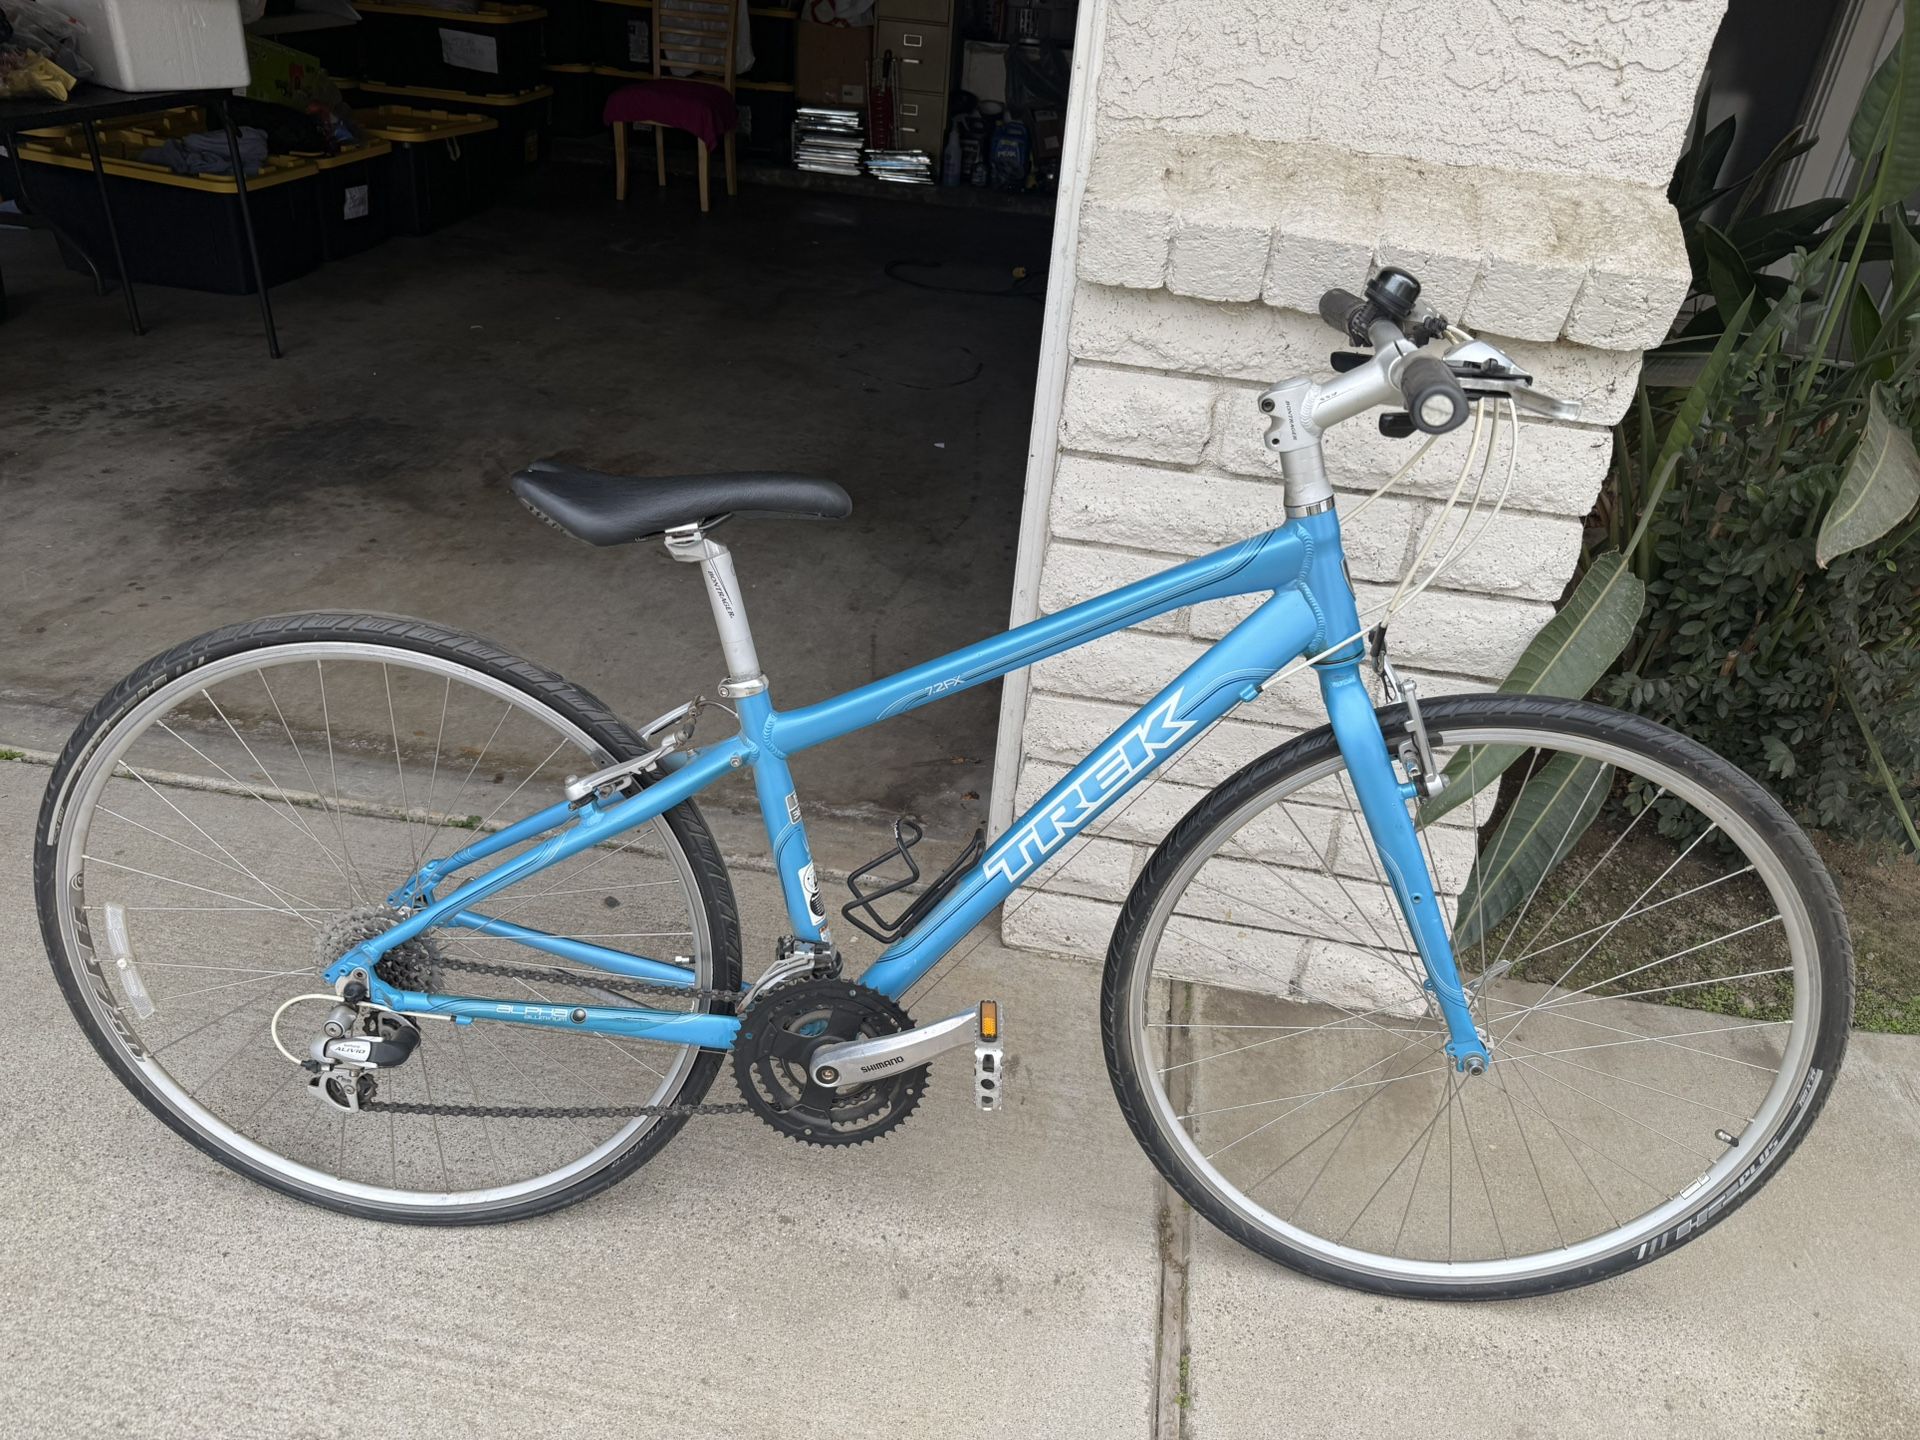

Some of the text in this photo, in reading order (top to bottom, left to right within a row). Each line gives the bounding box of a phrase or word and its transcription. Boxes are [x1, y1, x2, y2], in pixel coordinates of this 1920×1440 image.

[982, 685, 1199, 884] TREK
[861, 1056, 905, 1073] SHIMANO
[1739, 1138, 1779, 1187] PLUS
